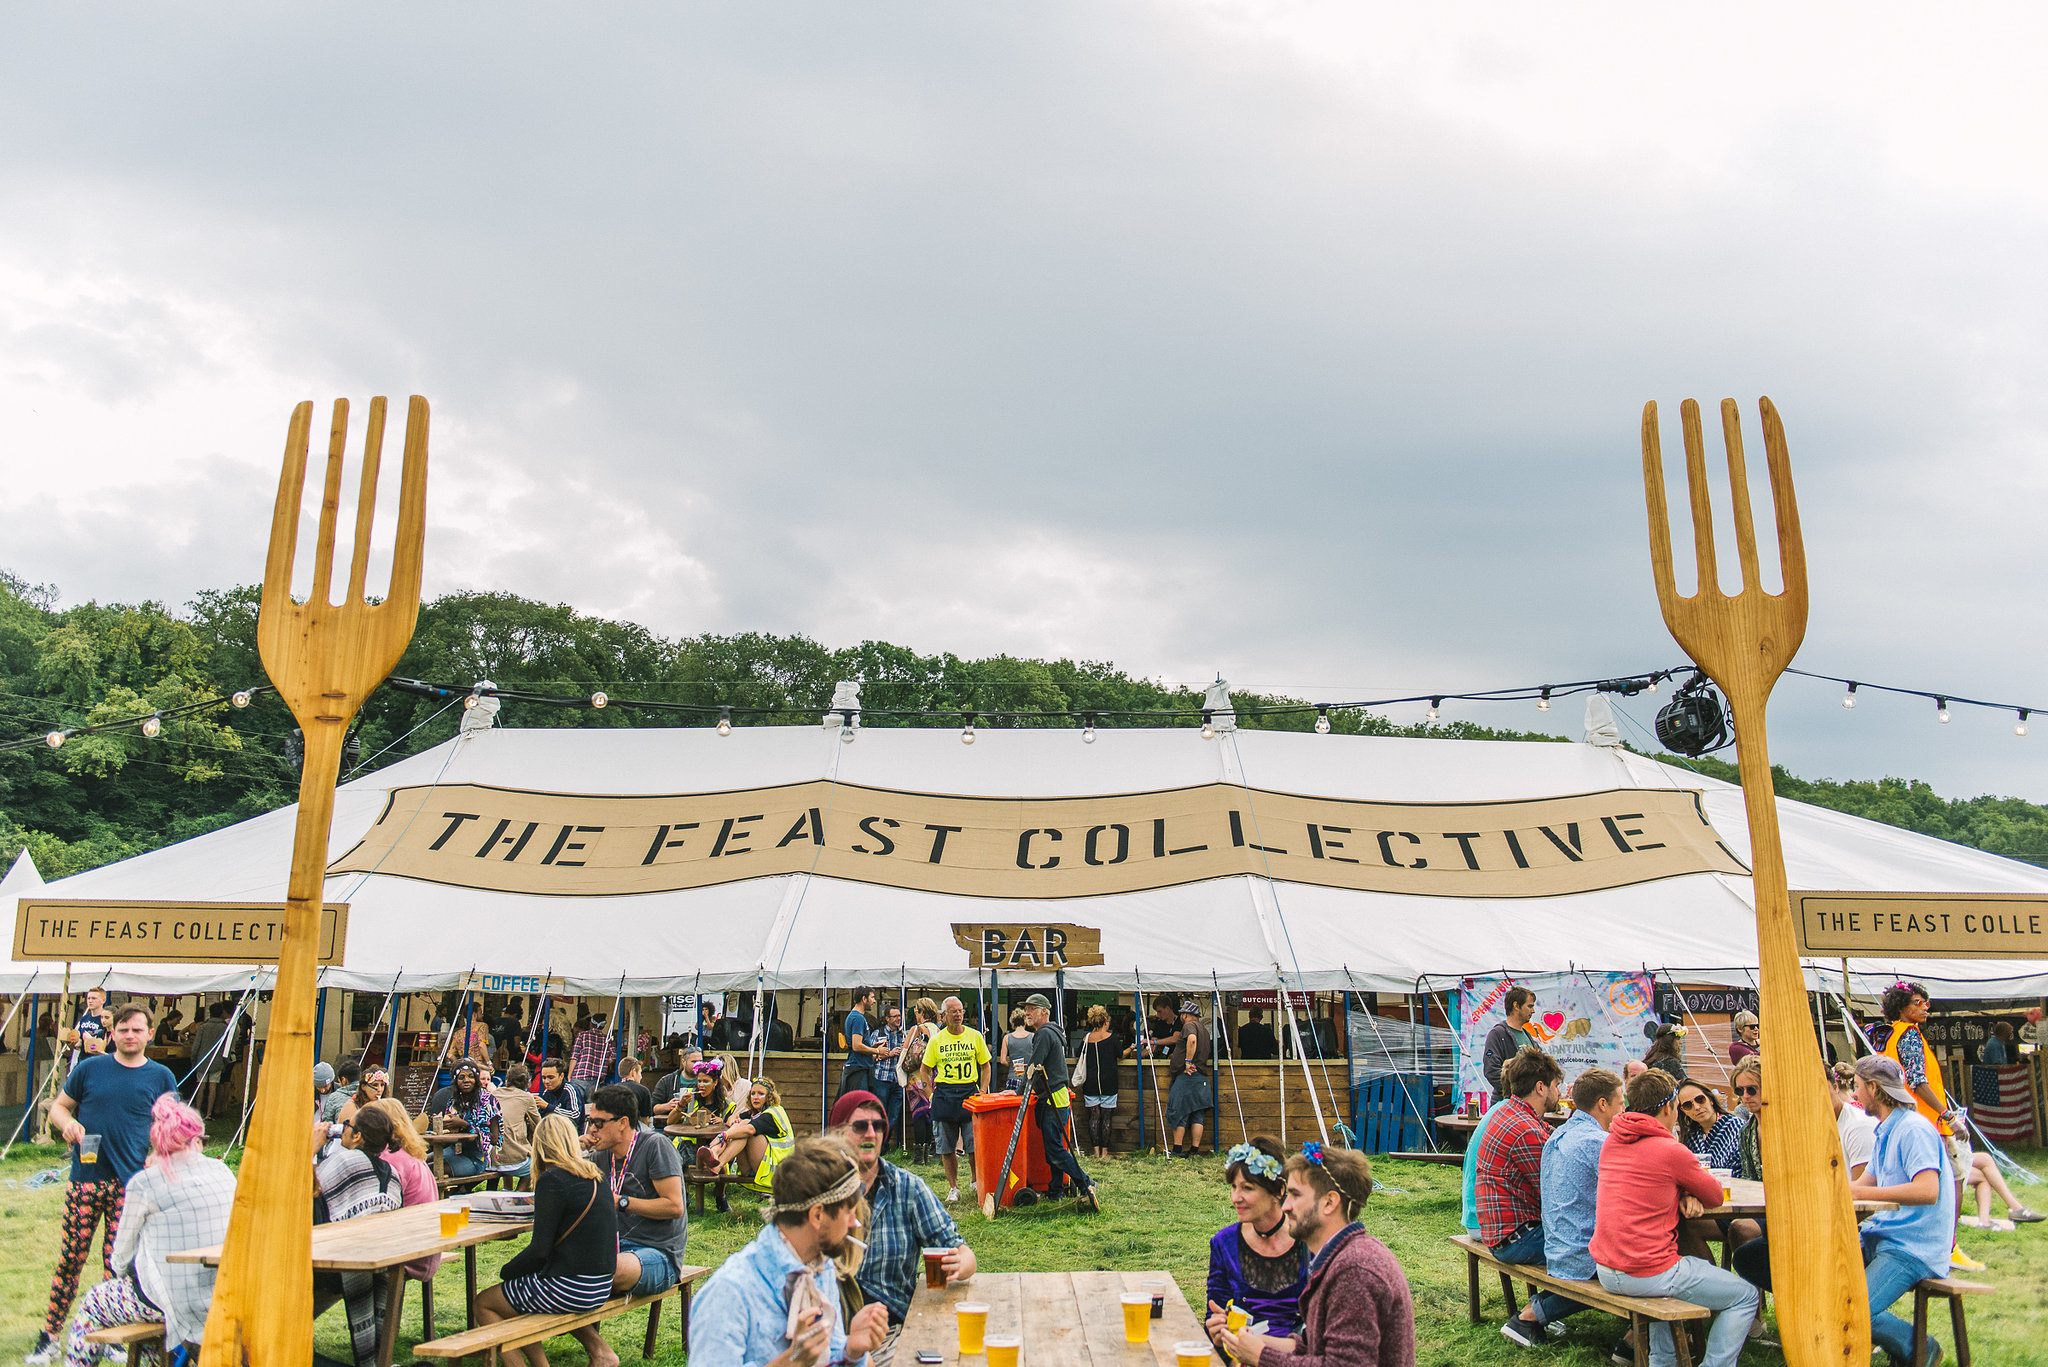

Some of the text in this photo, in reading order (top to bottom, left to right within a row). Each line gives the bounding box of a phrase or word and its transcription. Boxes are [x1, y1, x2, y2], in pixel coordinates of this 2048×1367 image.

[428, 807, 1666, 871] THE FEAST COLLECTIVE
[40, 919, 79, 938] THE
[89, 920, 162, 940] FEAST
[1817, 912, 2042, 934] THE FEAST COLLE
[982, 928, 1068, 967] BAR
[482, 975, 540, 992] COFFEE
[662, 995, 695, 1004] rise
[1926, 1022, 1947, 1040] ste
[1964, 1021, 1984, 1039] the
[940, 1041, 974, 1053] BESTIVAL
[944, 1062, 972, 1079] £10
